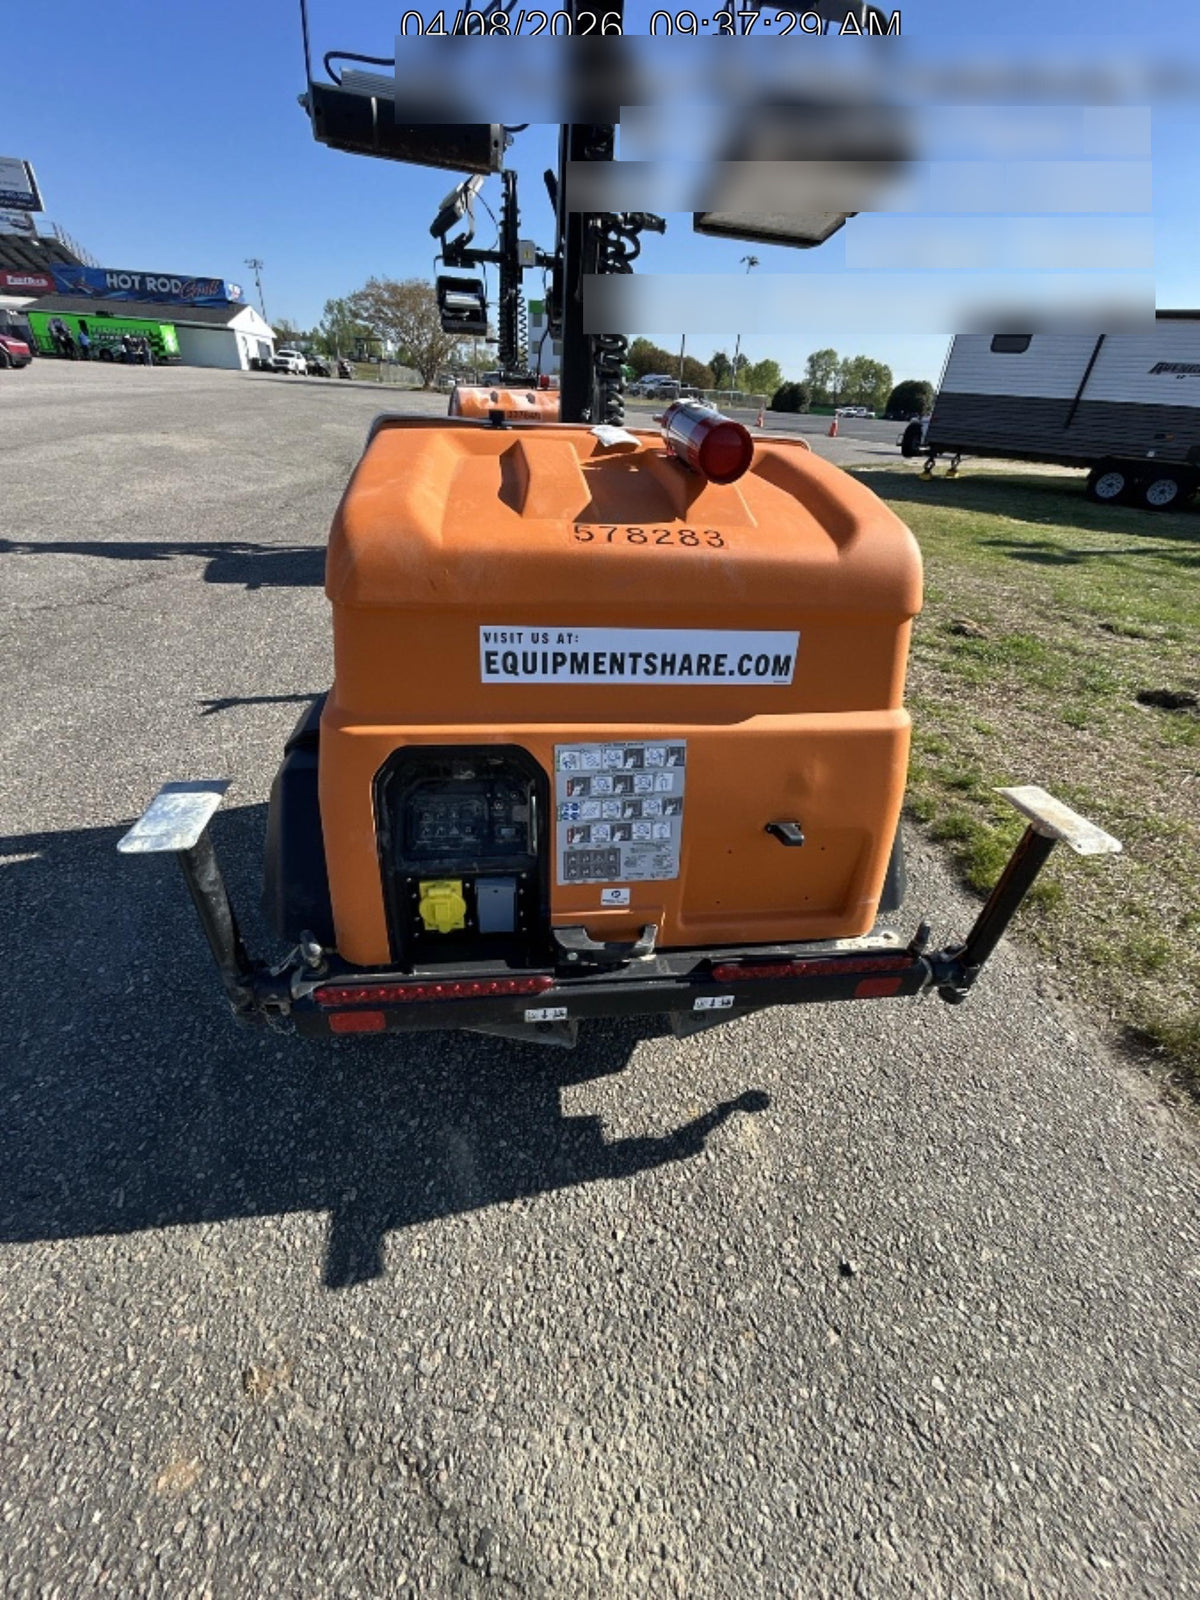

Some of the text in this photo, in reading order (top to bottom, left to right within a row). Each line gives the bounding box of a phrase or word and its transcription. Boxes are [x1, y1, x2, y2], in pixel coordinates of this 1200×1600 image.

[105, 273, 141, 290] HOT
[146, 277, 181, 294] ROD
[573, 524, 725, 548] 578283
[483, 632, 580, 645] VISIT US AT:
[484, 650, 792, 677] EQUIPMENTSHARE.COM
